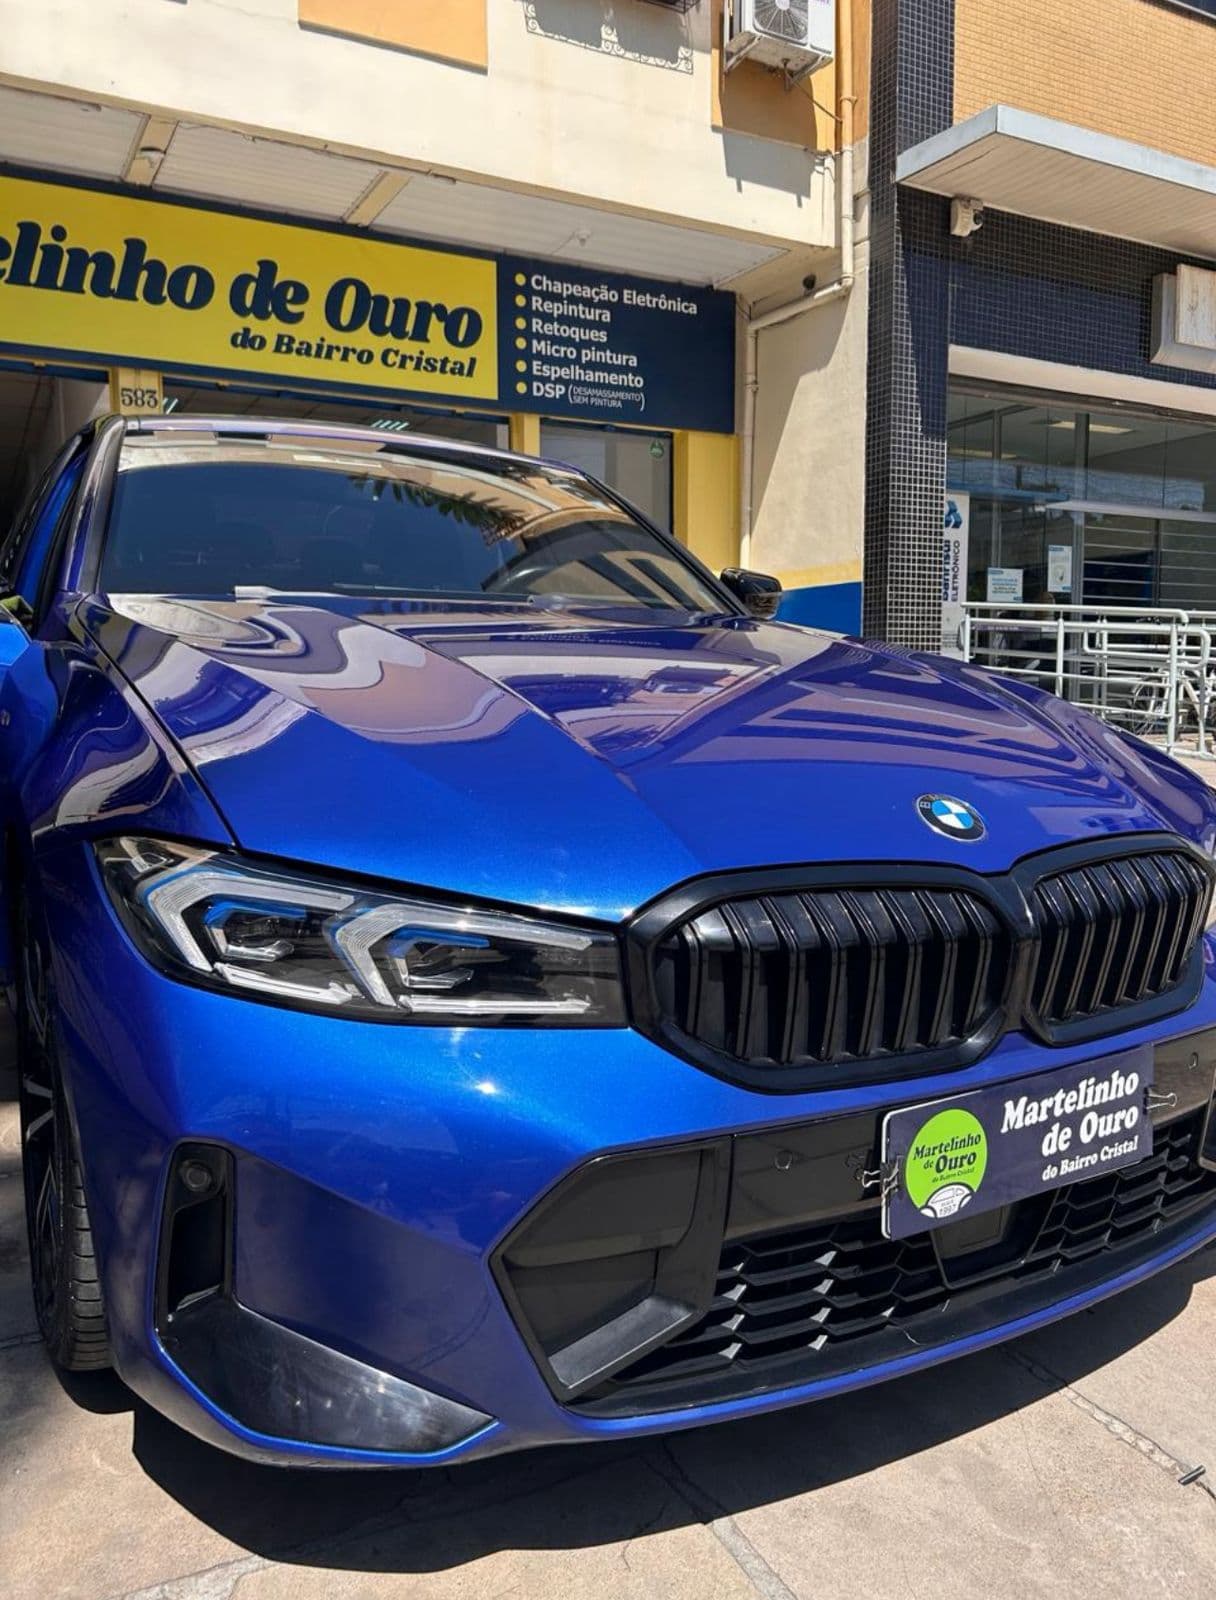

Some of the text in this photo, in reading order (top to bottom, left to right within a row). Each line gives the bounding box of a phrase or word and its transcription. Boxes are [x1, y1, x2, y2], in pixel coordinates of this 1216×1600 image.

[229, 259, 310, 325] de
[324, 277, 483, 349] Ouro
[531, 274, 698, 315] Chapeação Eletrônica
[532, 296, 611, 323] Repintura
[532, 318, 608, 343] Retoques
[230, 327, 477, 378] do Bairro Cristal
[532, 339, 638, 367] Micro pintura
[532, 361, 644, 388] Espelhamento
[121, 387, 158, 408] 583
[532, 381, 566, 399] DSP
[951, 540, 961, 602] ELETRÔNICO
[1000, 1070, 1139, 1133] Martelinho
[1042, 1106, 1139, 1157] de Ouro
[913, 1133, 982, 1160] Martelinho
[1042, 1135, 1139, 1181] do Bairro Cristal
[923, 1152, 977, 1174] de Ouro
